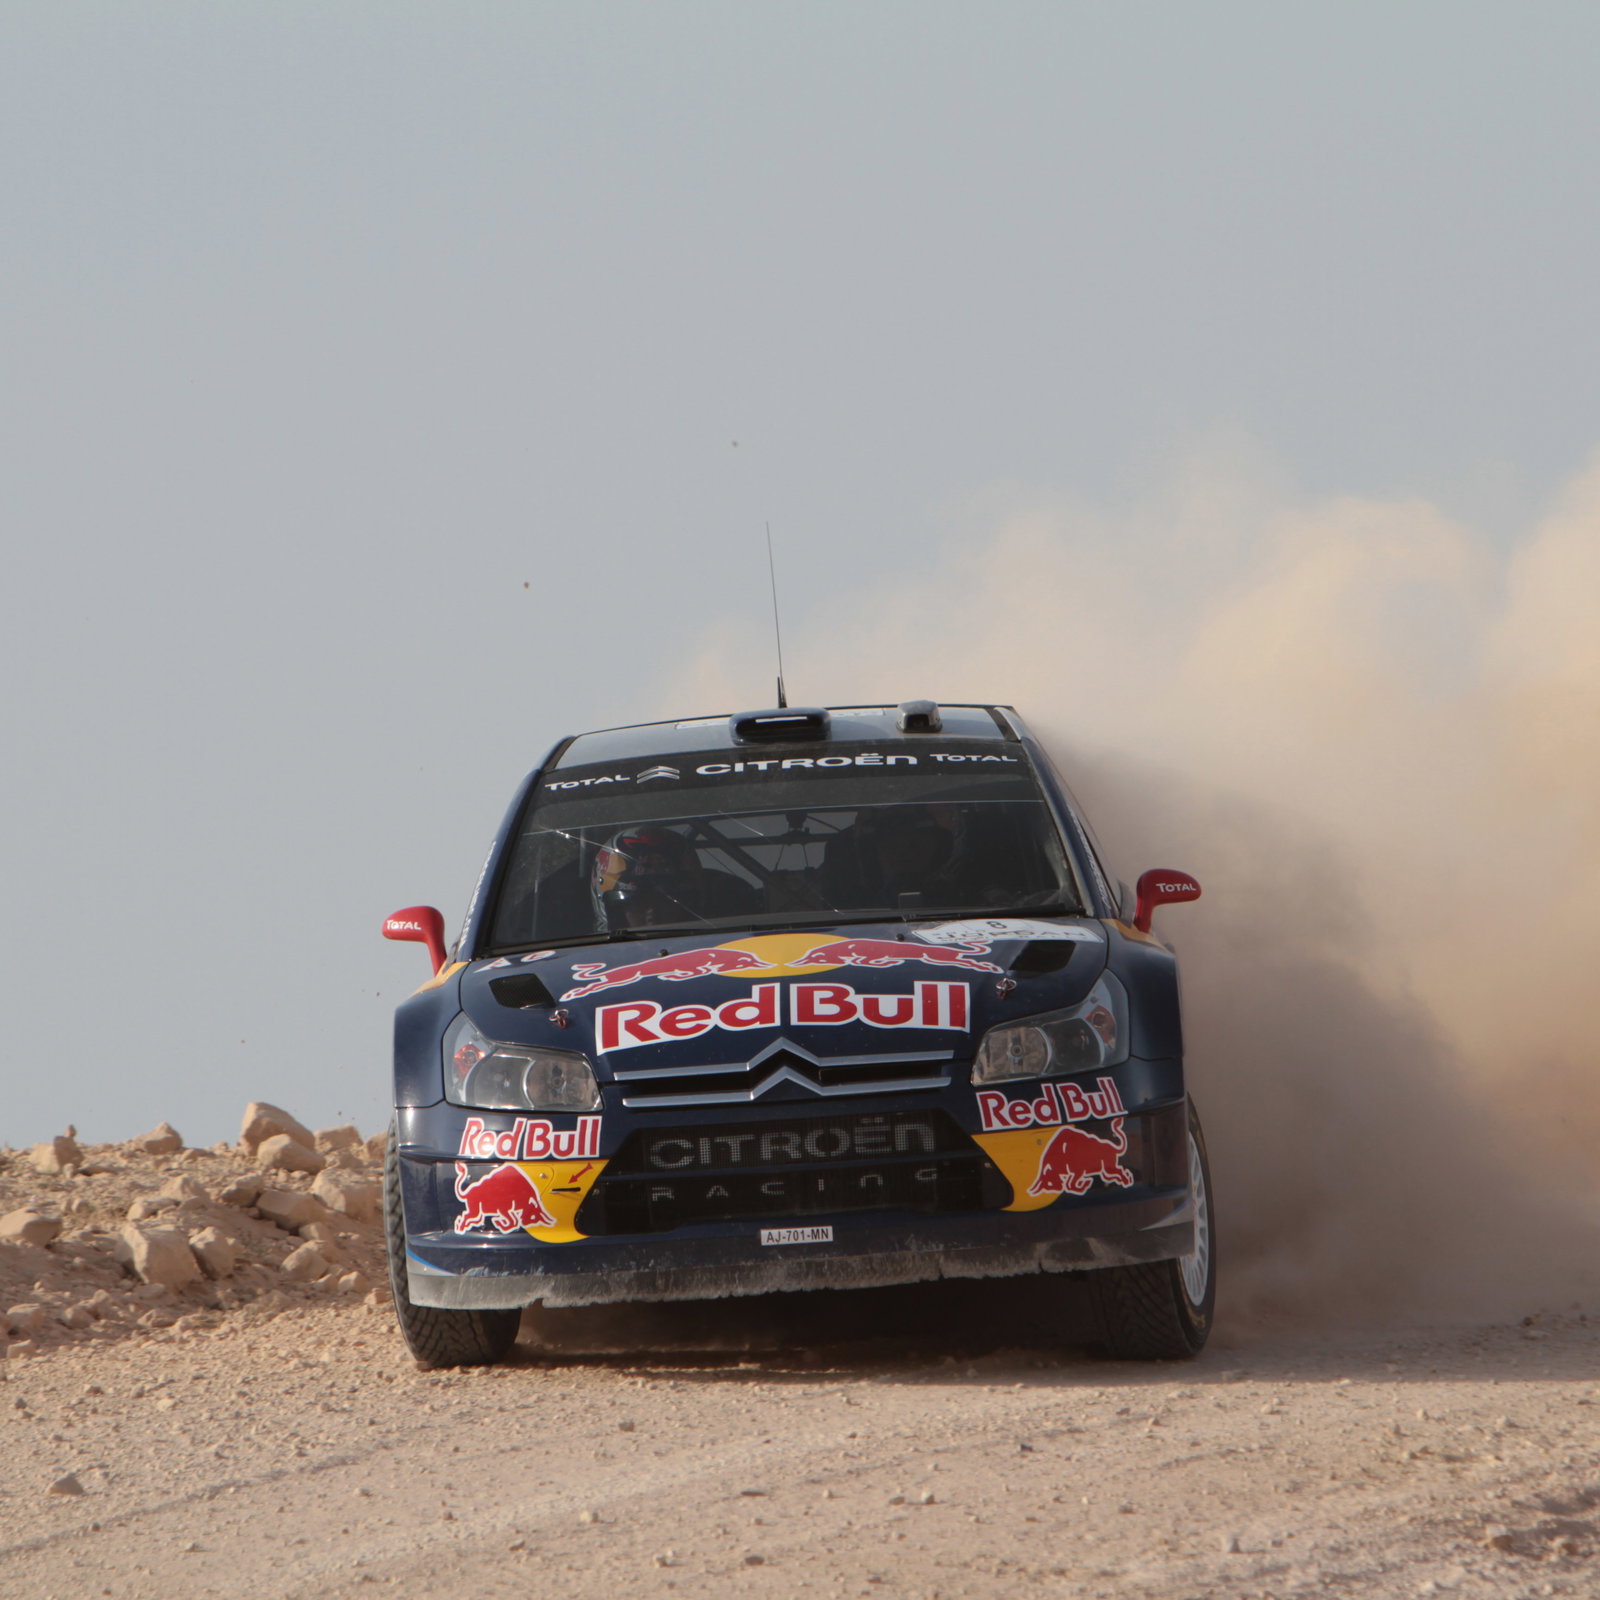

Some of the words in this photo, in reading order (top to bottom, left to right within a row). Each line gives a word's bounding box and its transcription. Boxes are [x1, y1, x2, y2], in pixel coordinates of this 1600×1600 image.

[929, 753, 1018, 762] TOTAL
[544, 774, 631, 791] TOTAL
[1155, 882, 1197, 893] TOTAL
[386, 919, 422, 930] TOTAL
[600, 984, 777, 1051] Red
[792, 982, 968, 1030] Bull
[978, 1085, 1061, 1130] Red
[1057, 1078, 1126, 1122] Bull
[460, 1117, 526, 1159] Red
[524, 1117, 602, 1159] Bull
[766, 1227, 829, 1243] AJ-701-MN
